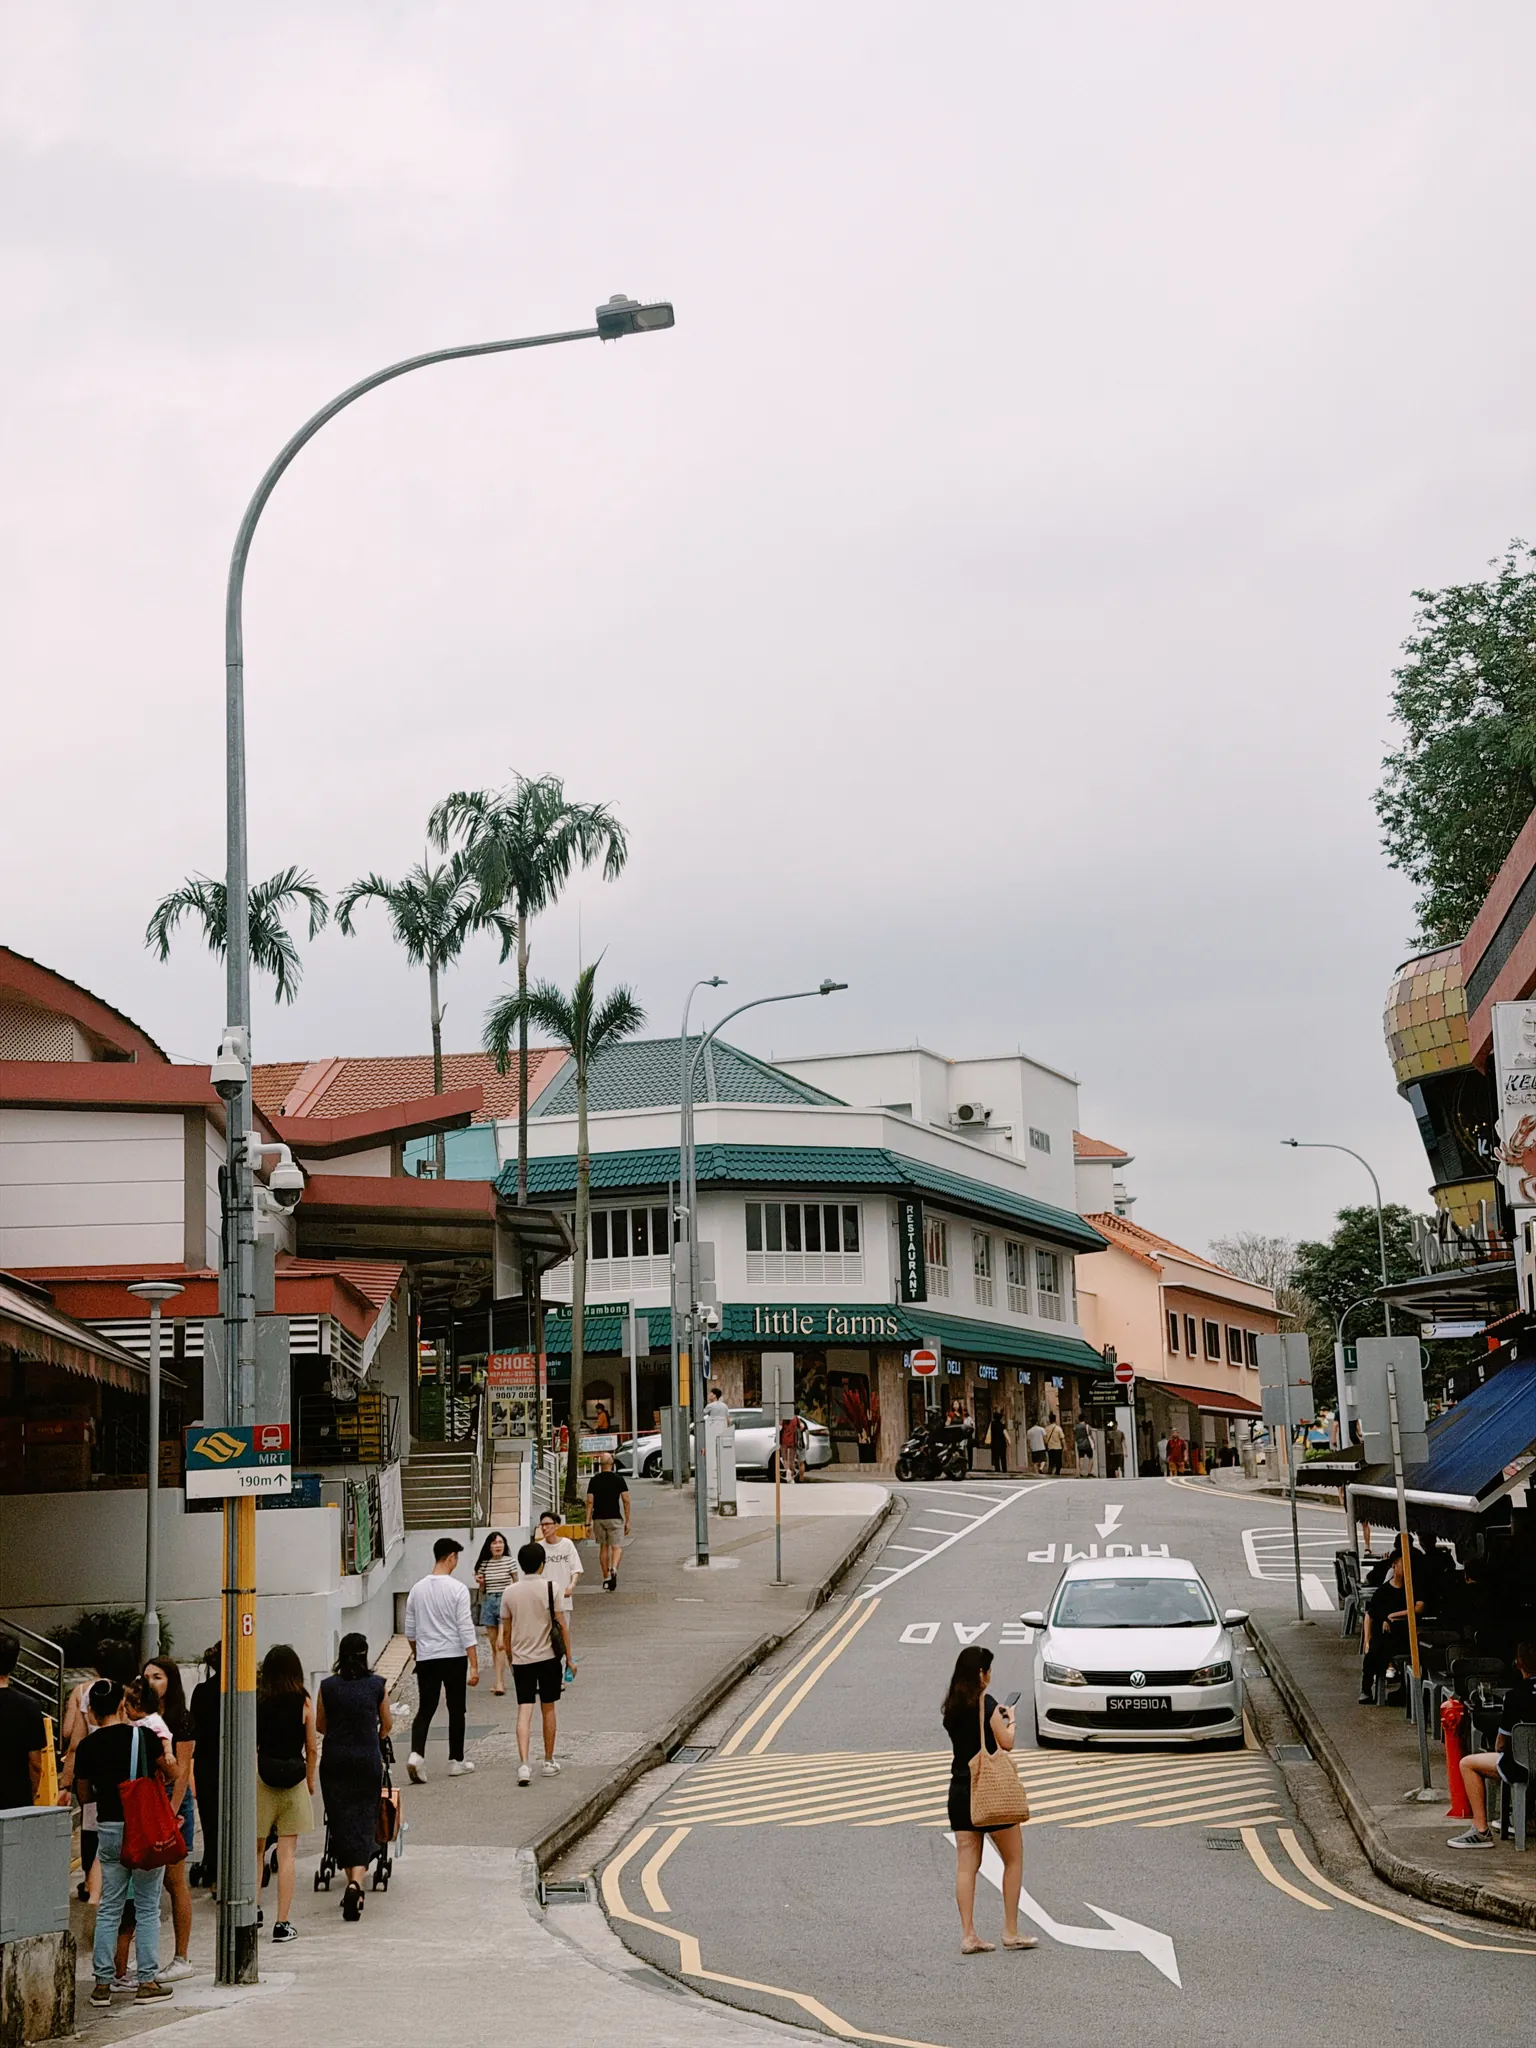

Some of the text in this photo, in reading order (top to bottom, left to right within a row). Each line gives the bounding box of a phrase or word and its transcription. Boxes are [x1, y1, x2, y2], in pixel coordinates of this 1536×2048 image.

[906, 1205, 917, 1298] RESTAURANT
[561, 1308, 573, 1317] Lo
[755, 1307, 898, 1335] little farms
[947, 1360, 961, 1375] DELI
[979, 1364, 998, 1380] COFFEE
[258, 1453, 285, 1464] MRT
[239, 1476, 272, 1487] 190m
[1027, 1543, 1171, 1564] HUMP
[243, 1614, 252, 1635] 8
